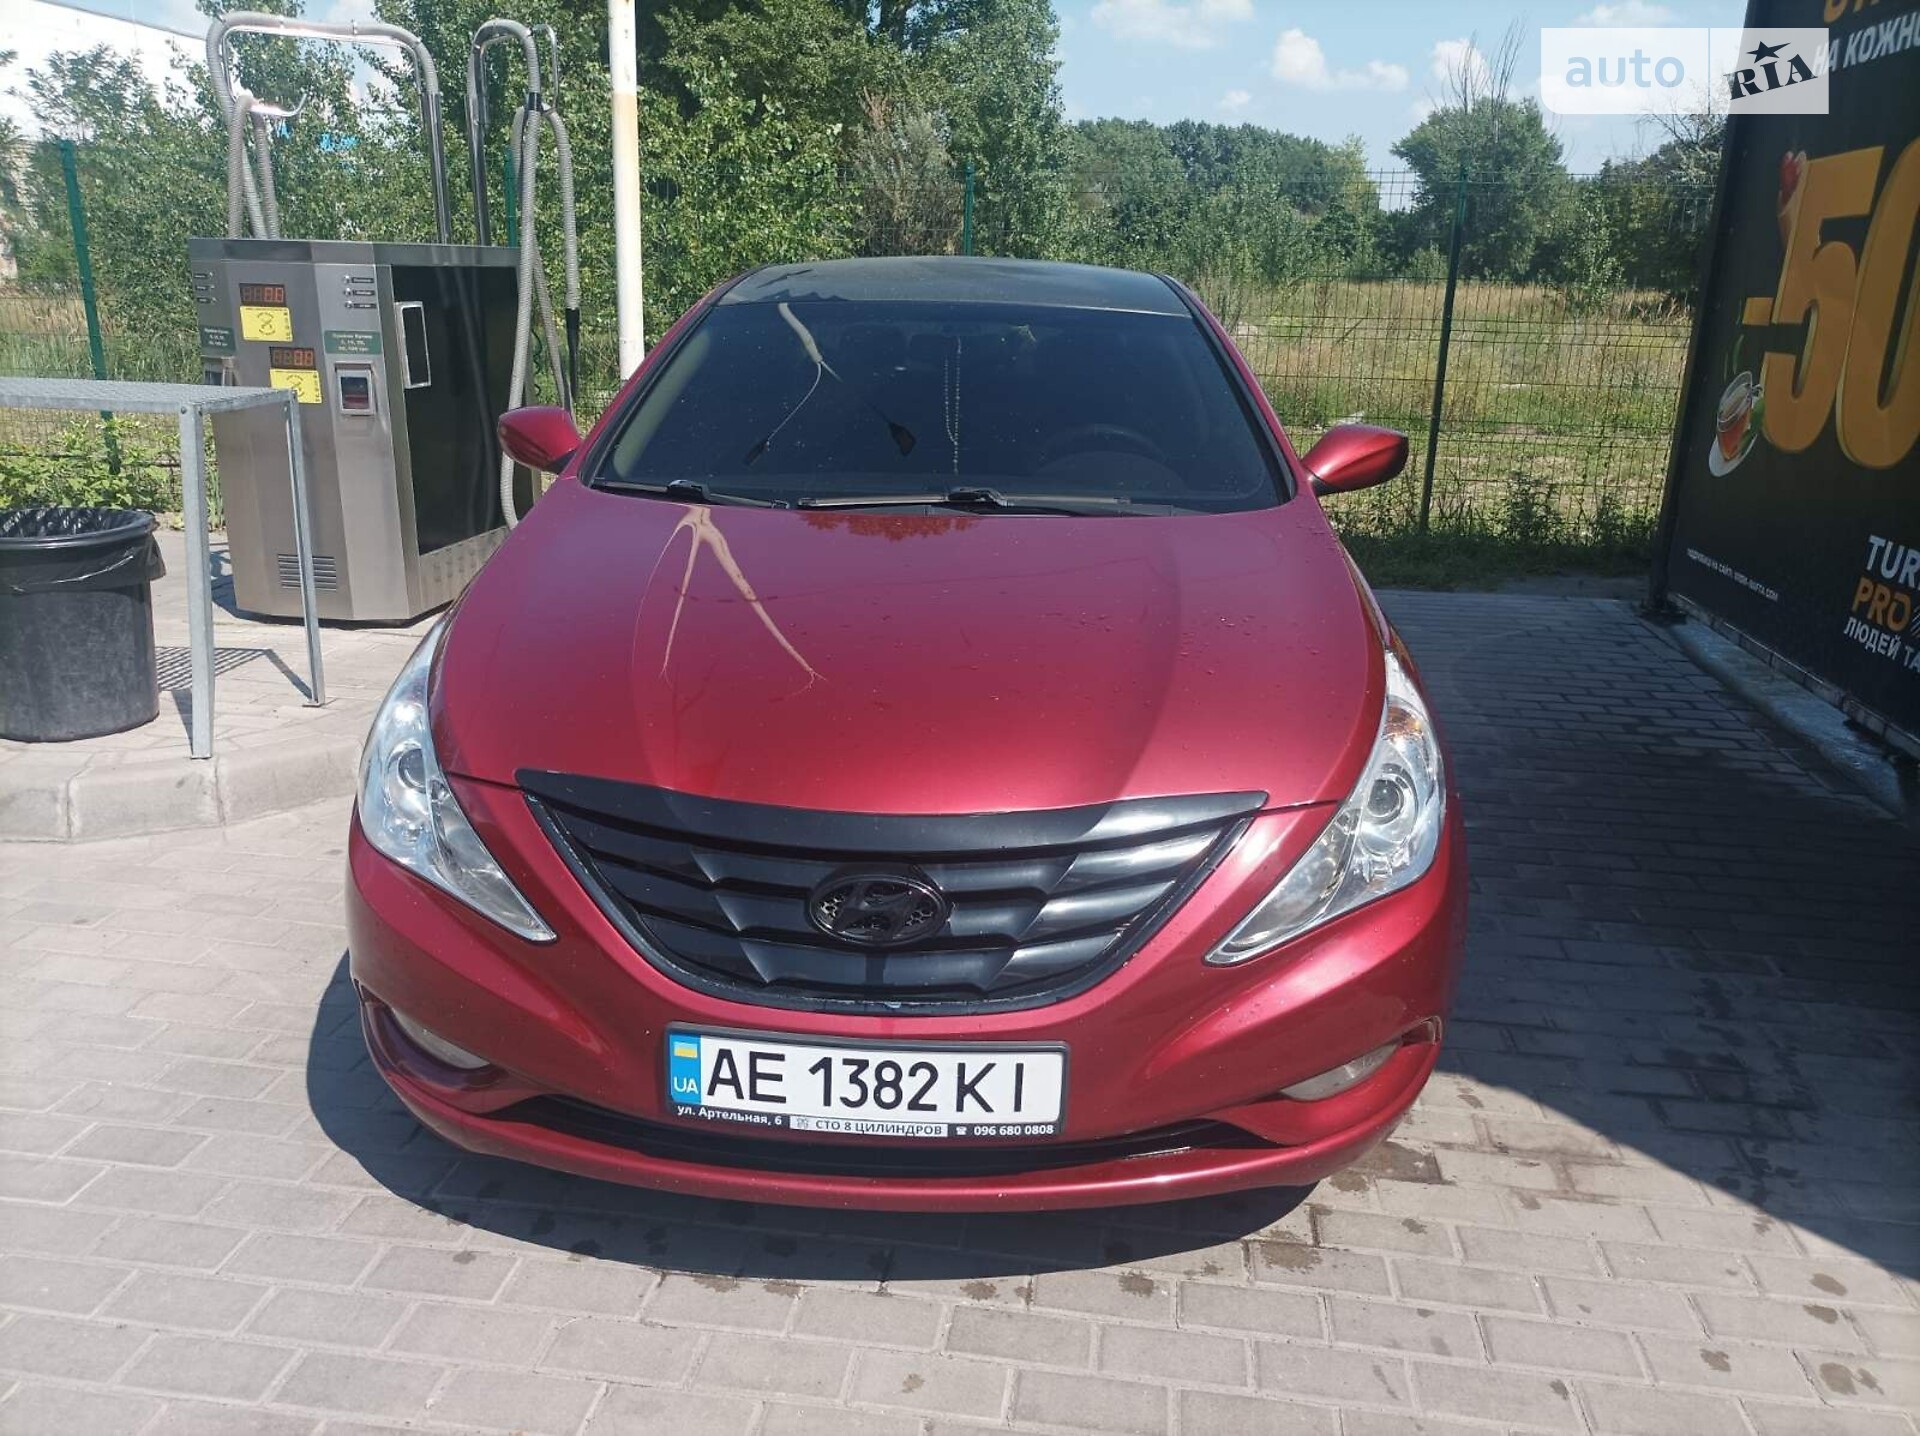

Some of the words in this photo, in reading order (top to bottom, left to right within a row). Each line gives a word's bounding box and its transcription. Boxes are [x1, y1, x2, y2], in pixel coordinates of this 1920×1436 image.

[1866, 535, 1920, 590] TUR
[1851, 577, 1911, 632] PRO
[1843, 616, 1901, 660] ЛЮДЕЙ
[673, 1076, 699, 1094] UA
[707, 1048, 787, 1104] AE
[808, 1056, 939, 1111] 1382
[956, 1062, 1024, 1112] KI
[677, 1105, 696, 1116] ул.
[698, 1107, 772, 1126] Артельная,
[774, 1116, 782, 1126] 6
[815, 1119, 841, 1131] СТО
[844, 1121, 852, 1132] 8
[855, 1123, 942, 1139] ЦИЛИНДРОВ
[973, 1125, 997, 1136] 096
[999, 1125, 1021, 1136] 680
[1024, 1124, 1054, 1135] 0808
